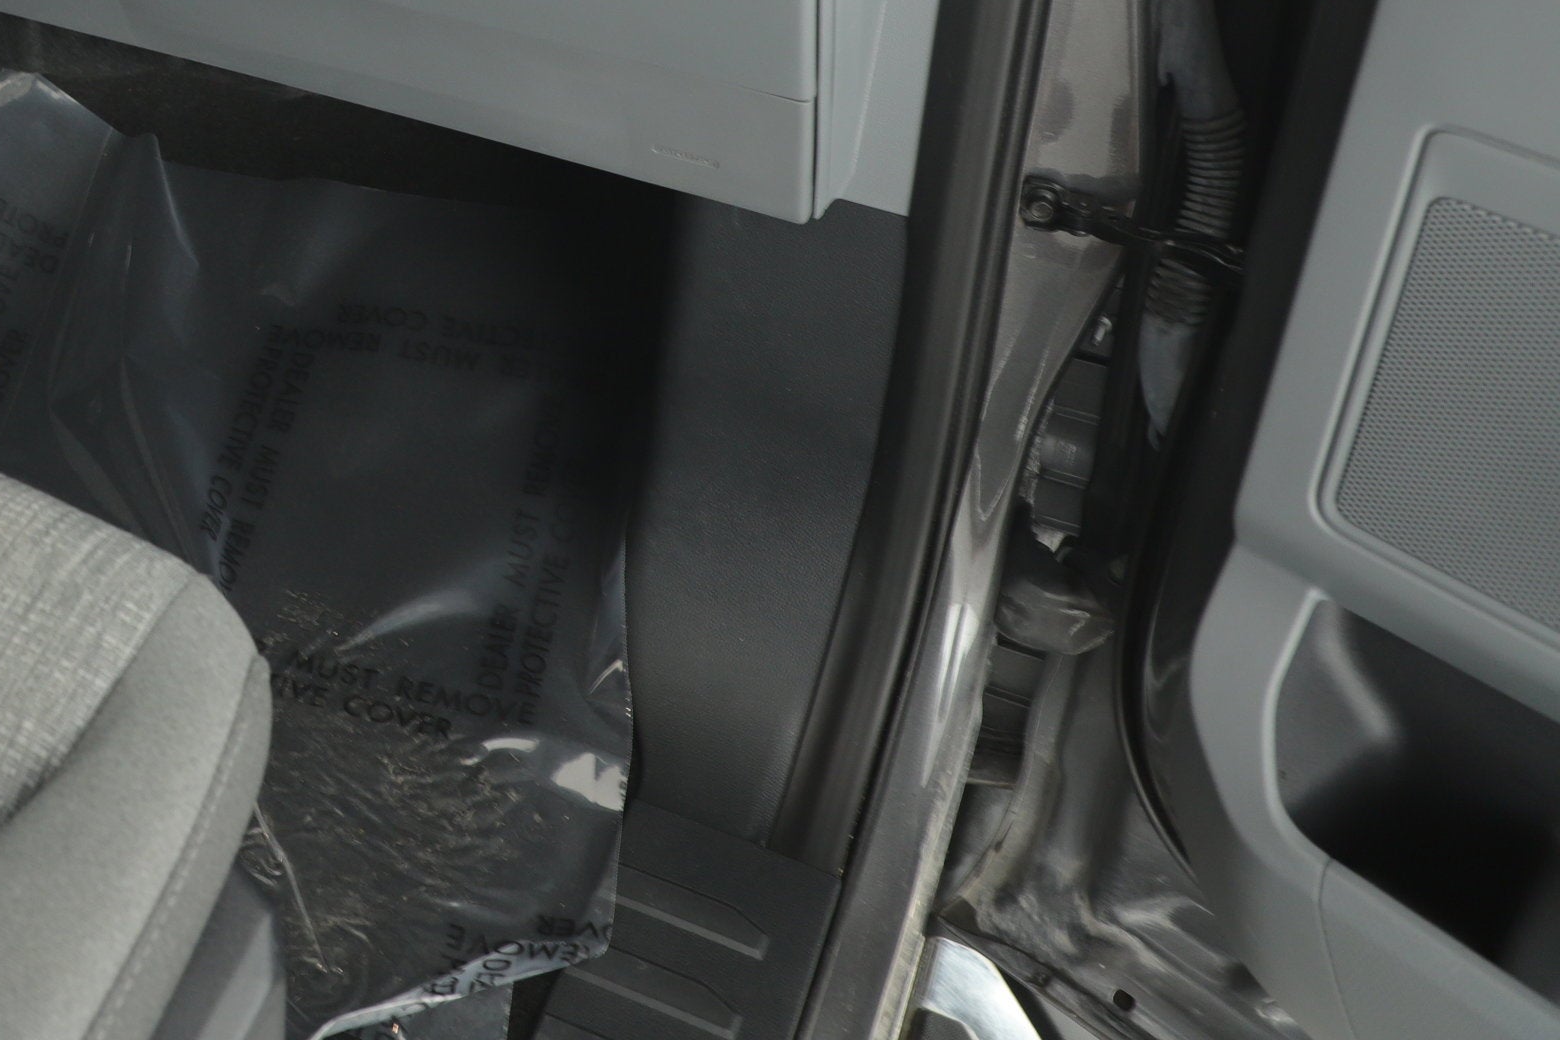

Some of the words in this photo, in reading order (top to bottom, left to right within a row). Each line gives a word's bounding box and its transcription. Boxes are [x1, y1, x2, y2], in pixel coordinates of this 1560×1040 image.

[338, 304, 428, 332] COVER
[396, 338, 481, 372] MUST
[217, 345, 283, 472] PROTECTIVE
[266, 351, 316, 435] DEALER
[241, 445, 282, 510] MUST
[477, 601, 521, 692] DEALER
[502, 508, 541, 590] MUST
[516, 554, 572, 699] PROTECTIVE
[288, 649, 379, 690] MUST
[396, 675, 536, 726] REMOVE
[344, 695, 452, 740] COVER
